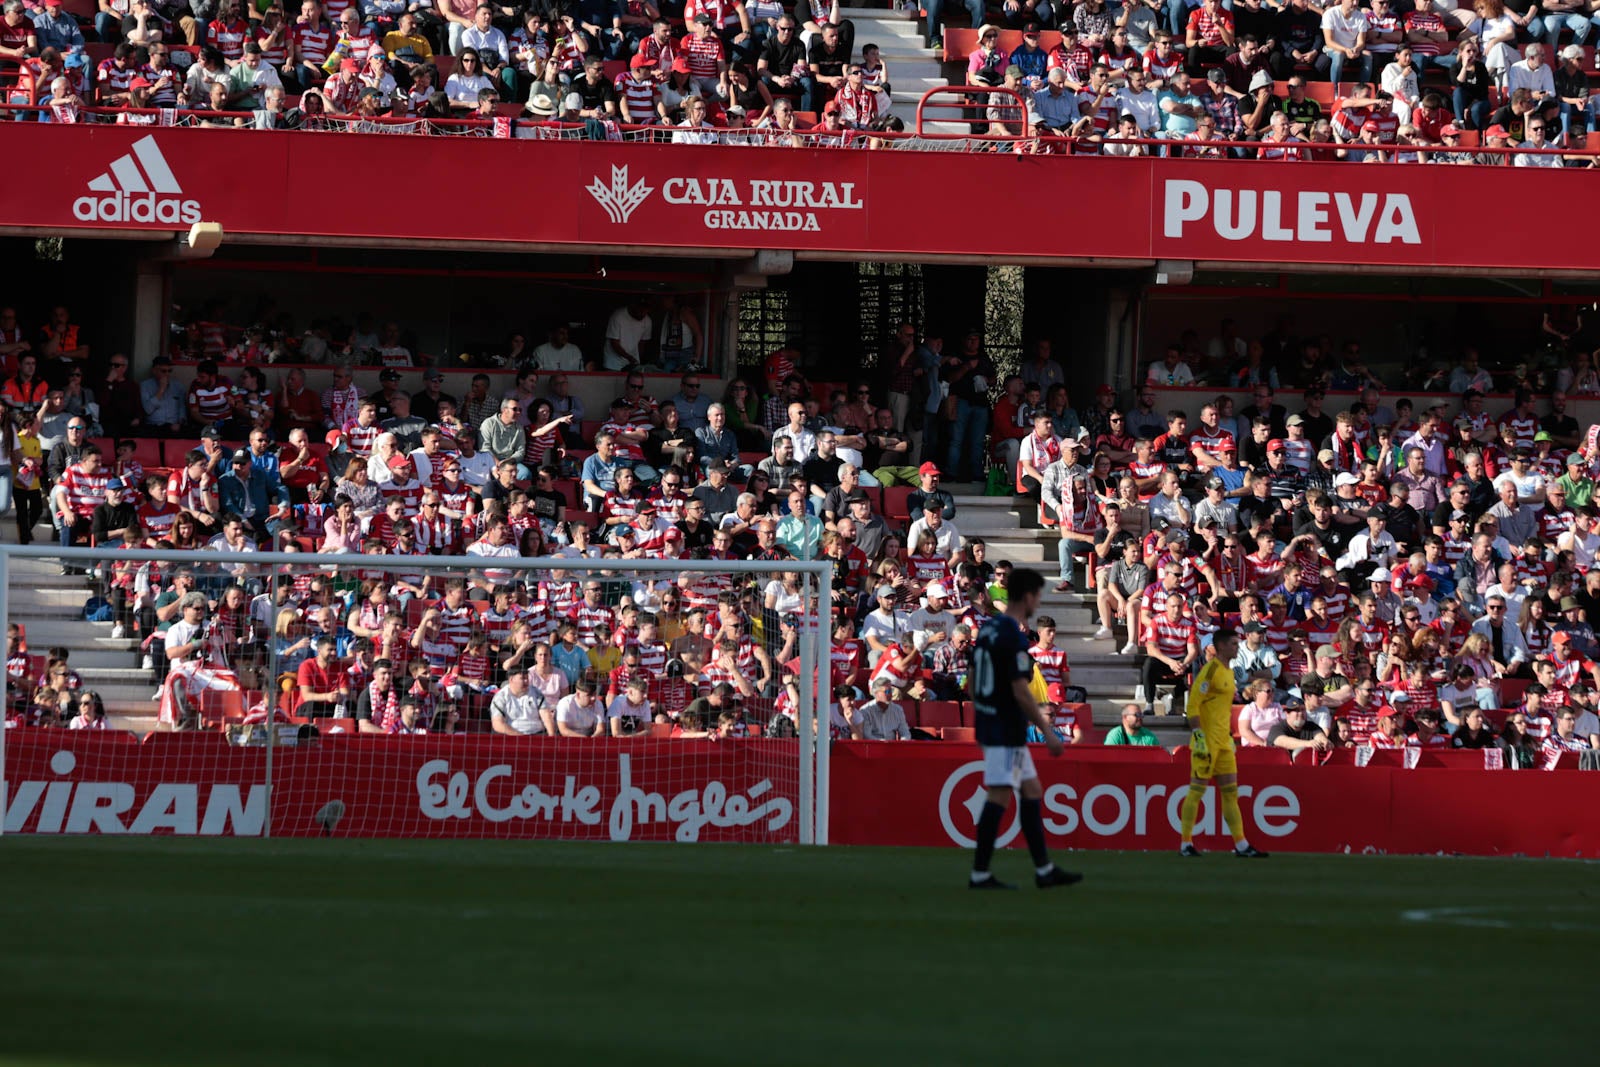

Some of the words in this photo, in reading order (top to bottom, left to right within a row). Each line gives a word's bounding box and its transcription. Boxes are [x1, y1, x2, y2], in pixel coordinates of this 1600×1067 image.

[73, 190, 201, 223] adidas
[662, 177, 743, 207] CAJA
[750, 179, 864, 209] RURAL
[704, 210, 821, 232] GRANADA
[1164, 179, 1422, 245] PULEVA
[416, 759, 471, 820] El
[474, 764, 602, 826] Corte
[609, 753, 793, 842] Inglés
